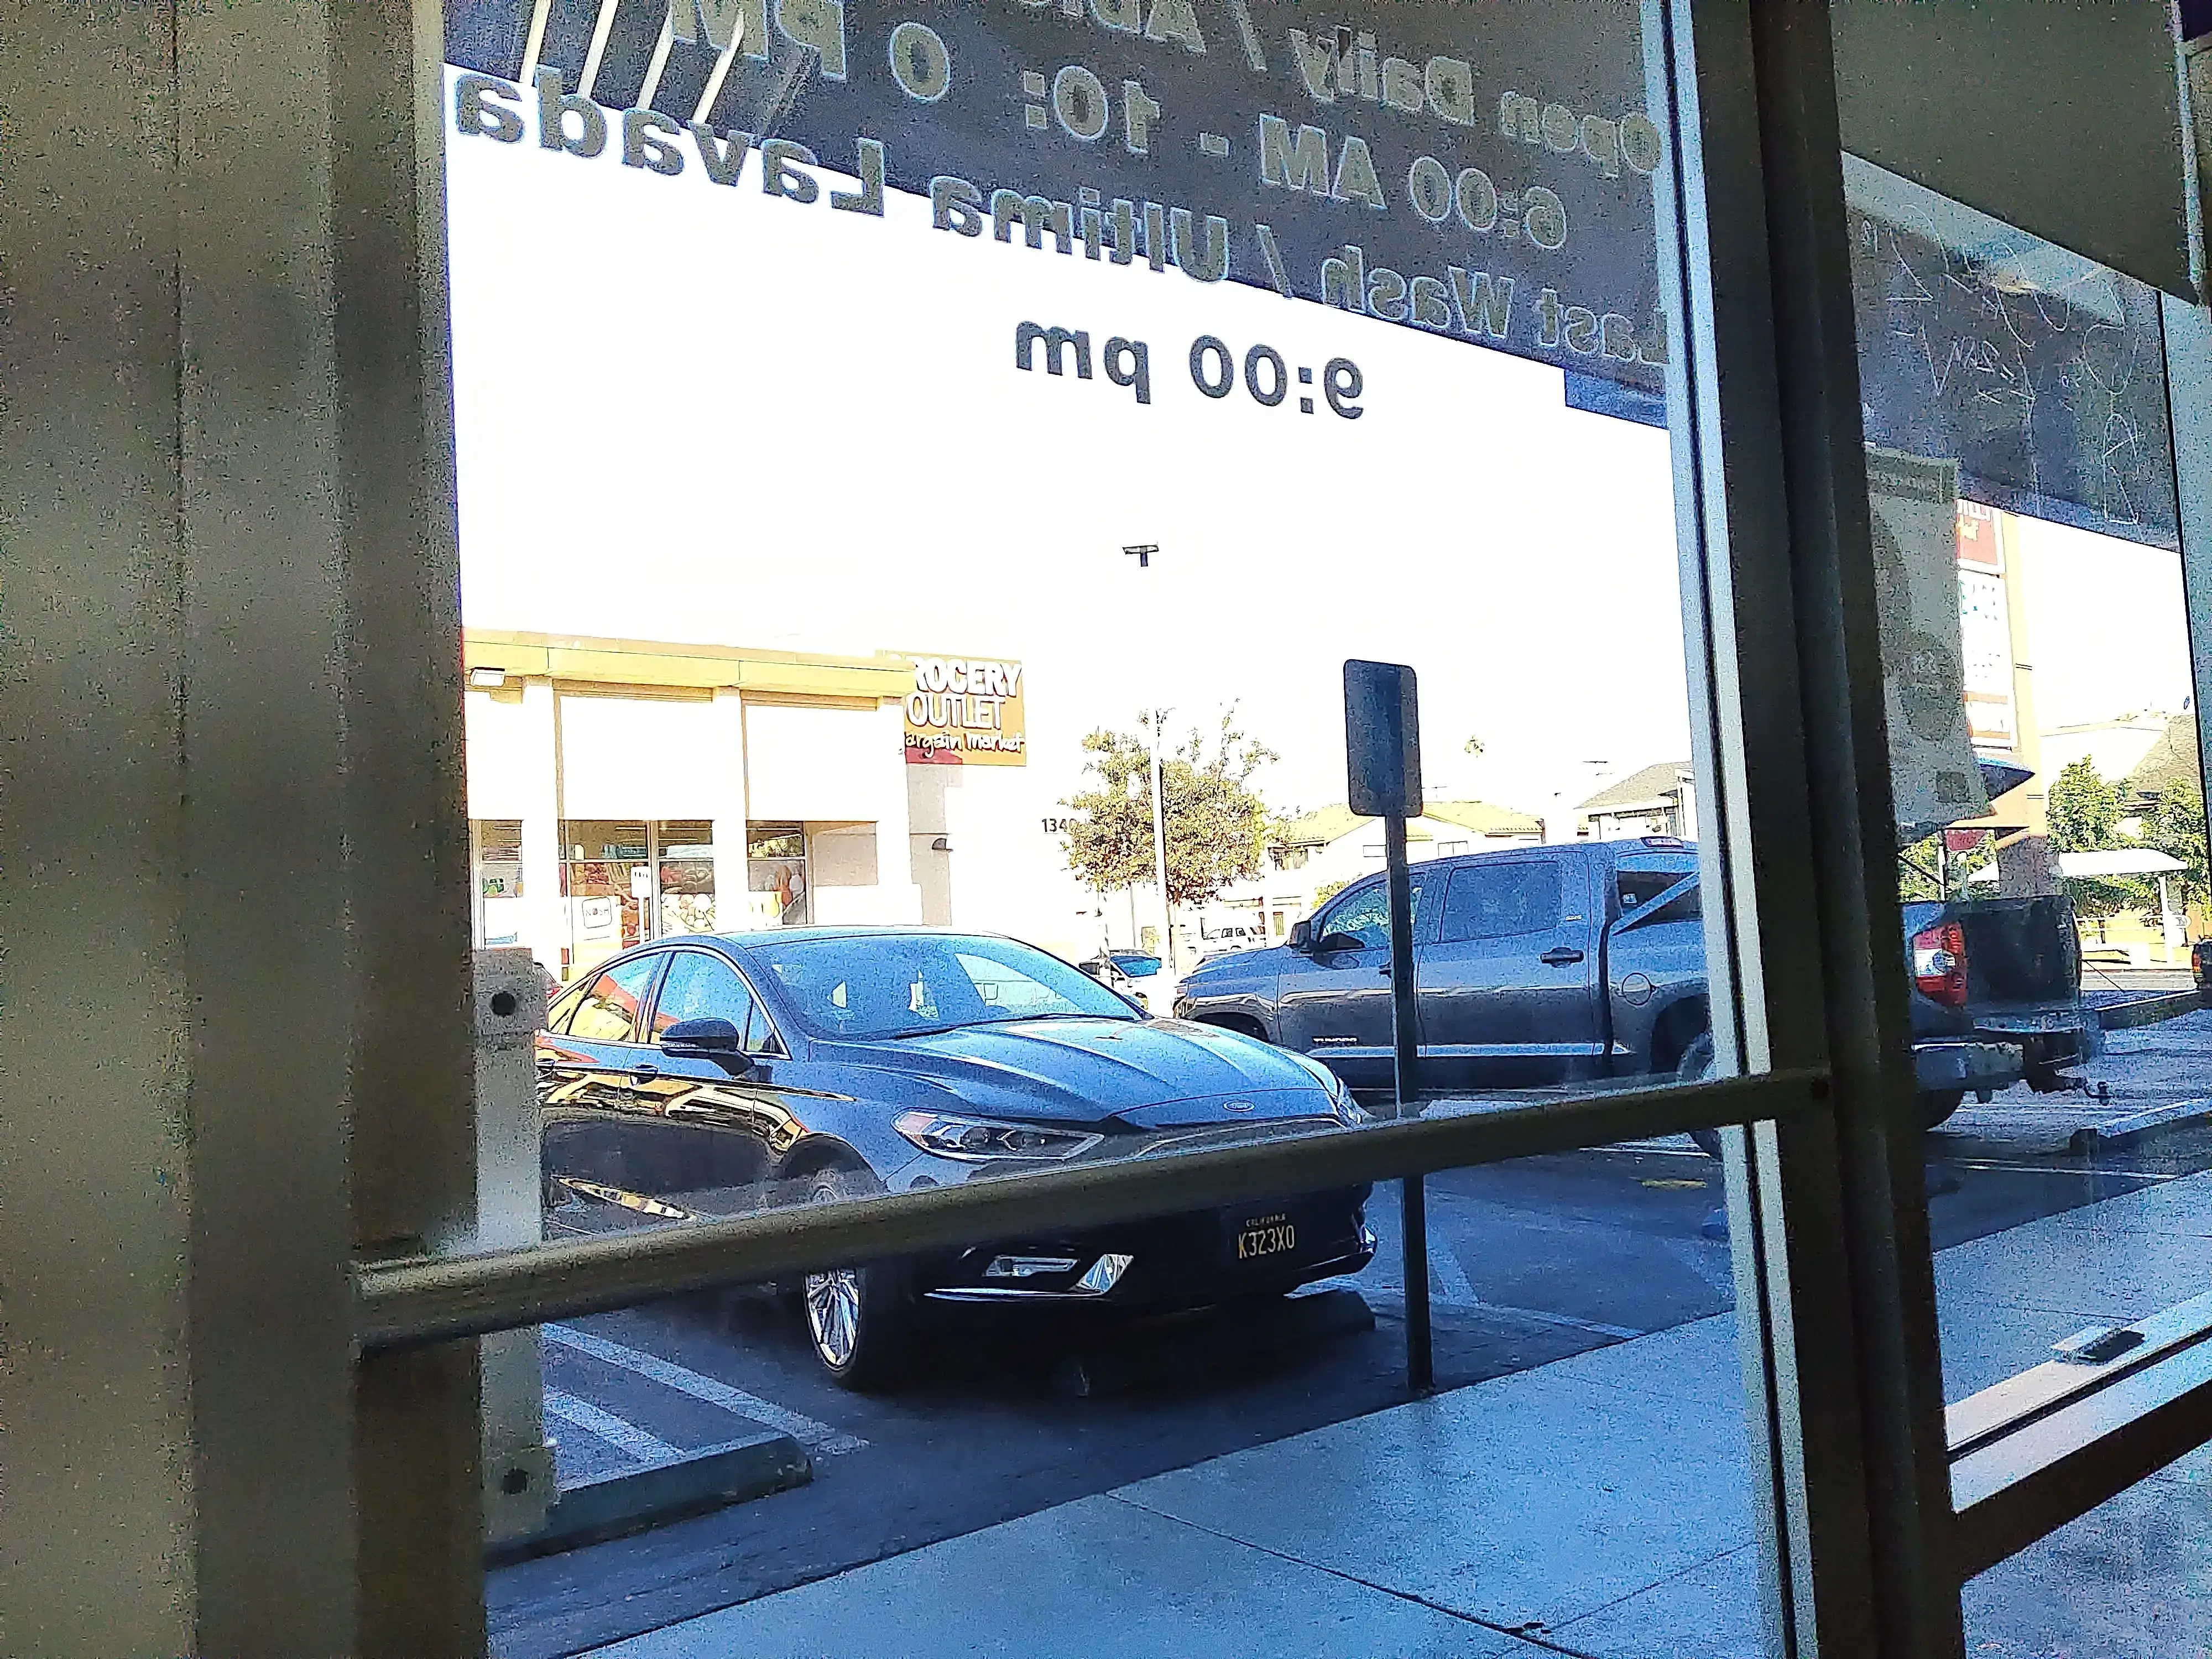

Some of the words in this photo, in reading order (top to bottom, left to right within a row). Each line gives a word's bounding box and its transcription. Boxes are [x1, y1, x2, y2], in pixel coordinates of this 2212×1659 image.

[912, 656, 1022, 698] ROCERY
[906, 692, 1006, 730] OUTLET
[905, 731, 963, 758] argain
[964, 730, 1025, 754] market
